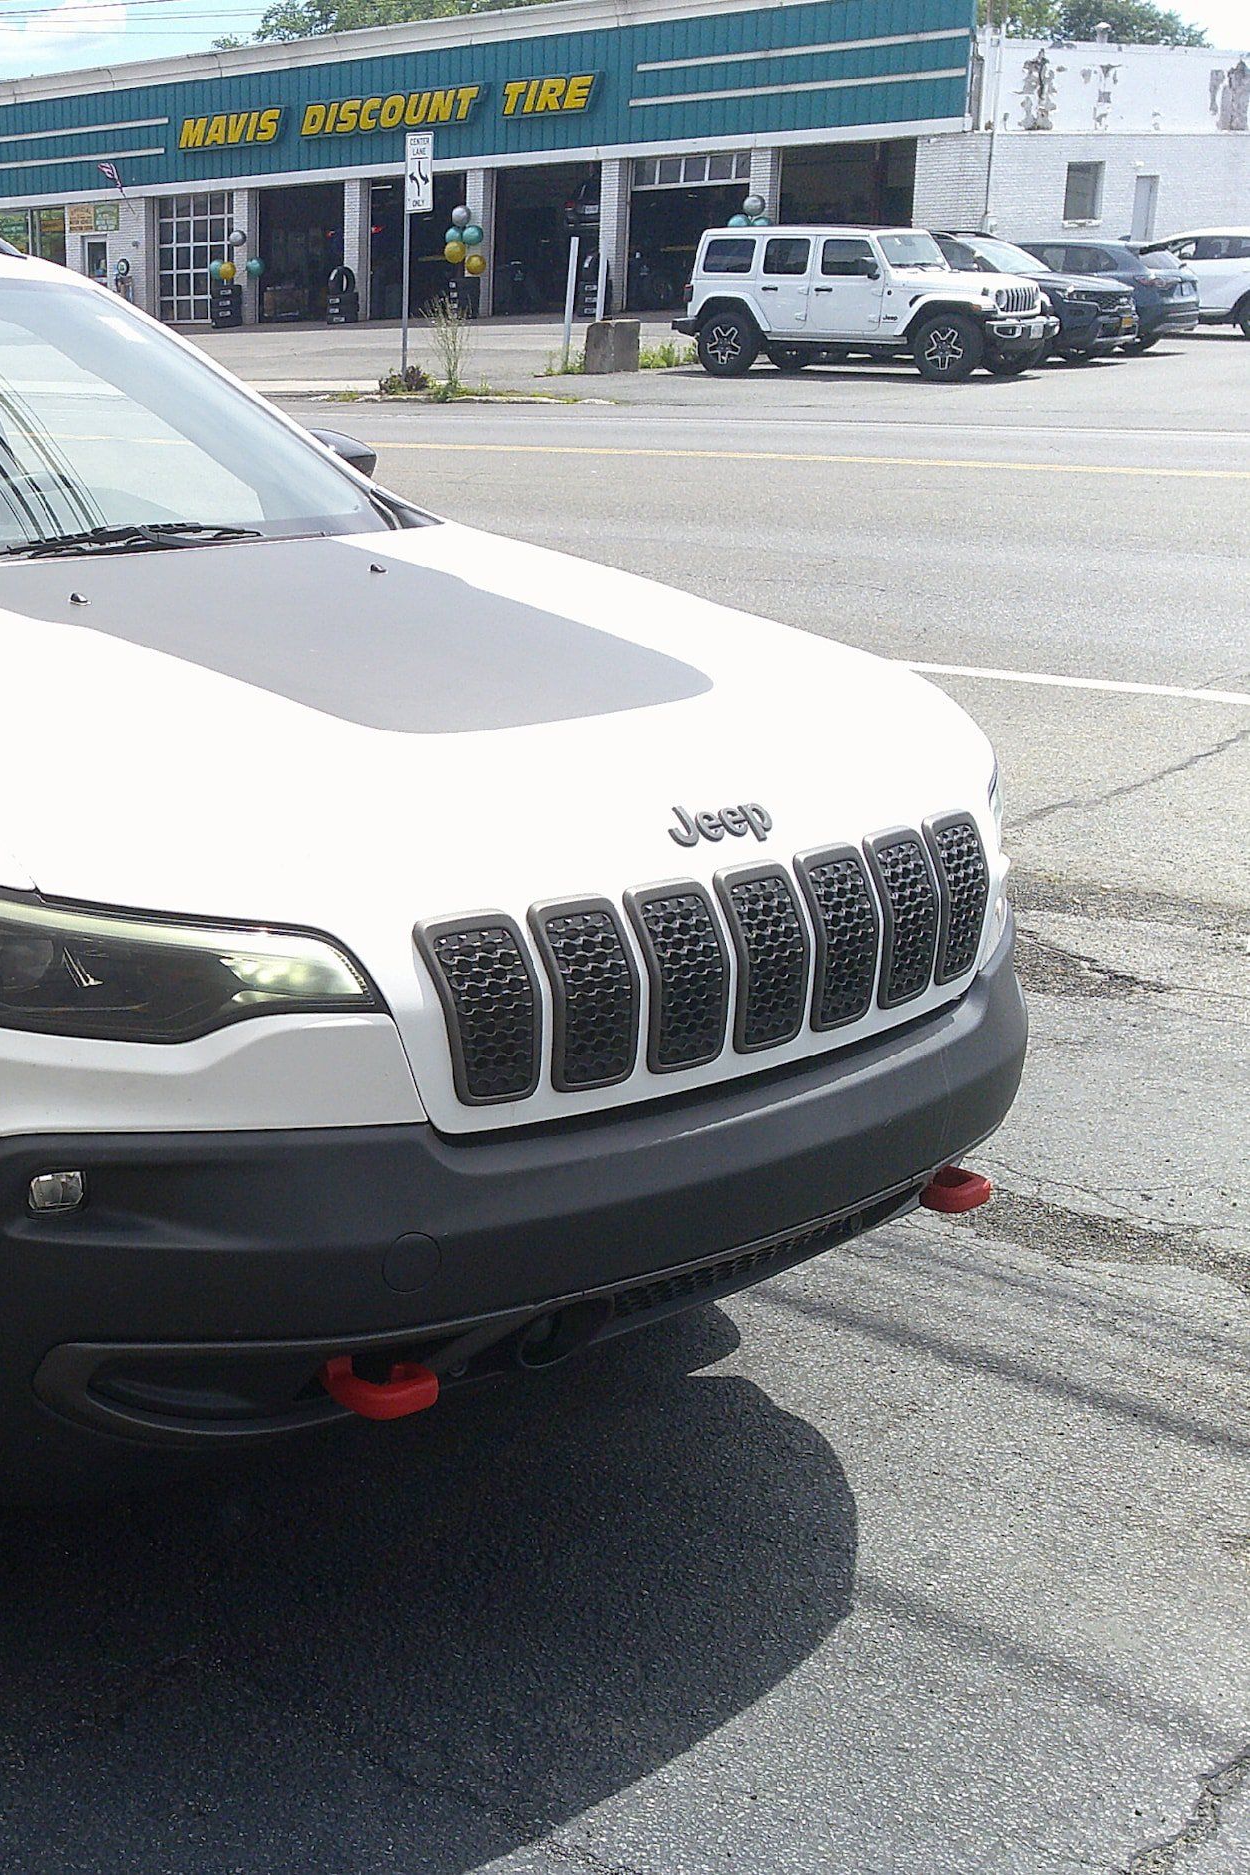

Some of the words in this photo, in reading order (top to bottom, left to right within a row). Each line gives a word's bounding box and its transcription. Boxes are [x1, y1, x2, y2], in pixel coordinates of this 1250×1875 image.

[178, 107, 282, 149] MAVIS
[300, 85, 480, 137] DISCOUNT
[502, 74, 596, 116] TIRE
[410, 137, 430, 146] CENTER
[412, 147, 427, 156] LANE
[412, 199, 425, 208] ONLY
[882, 314, 898, 322] Jeep
[668, 803, 772, 848] Jeep
